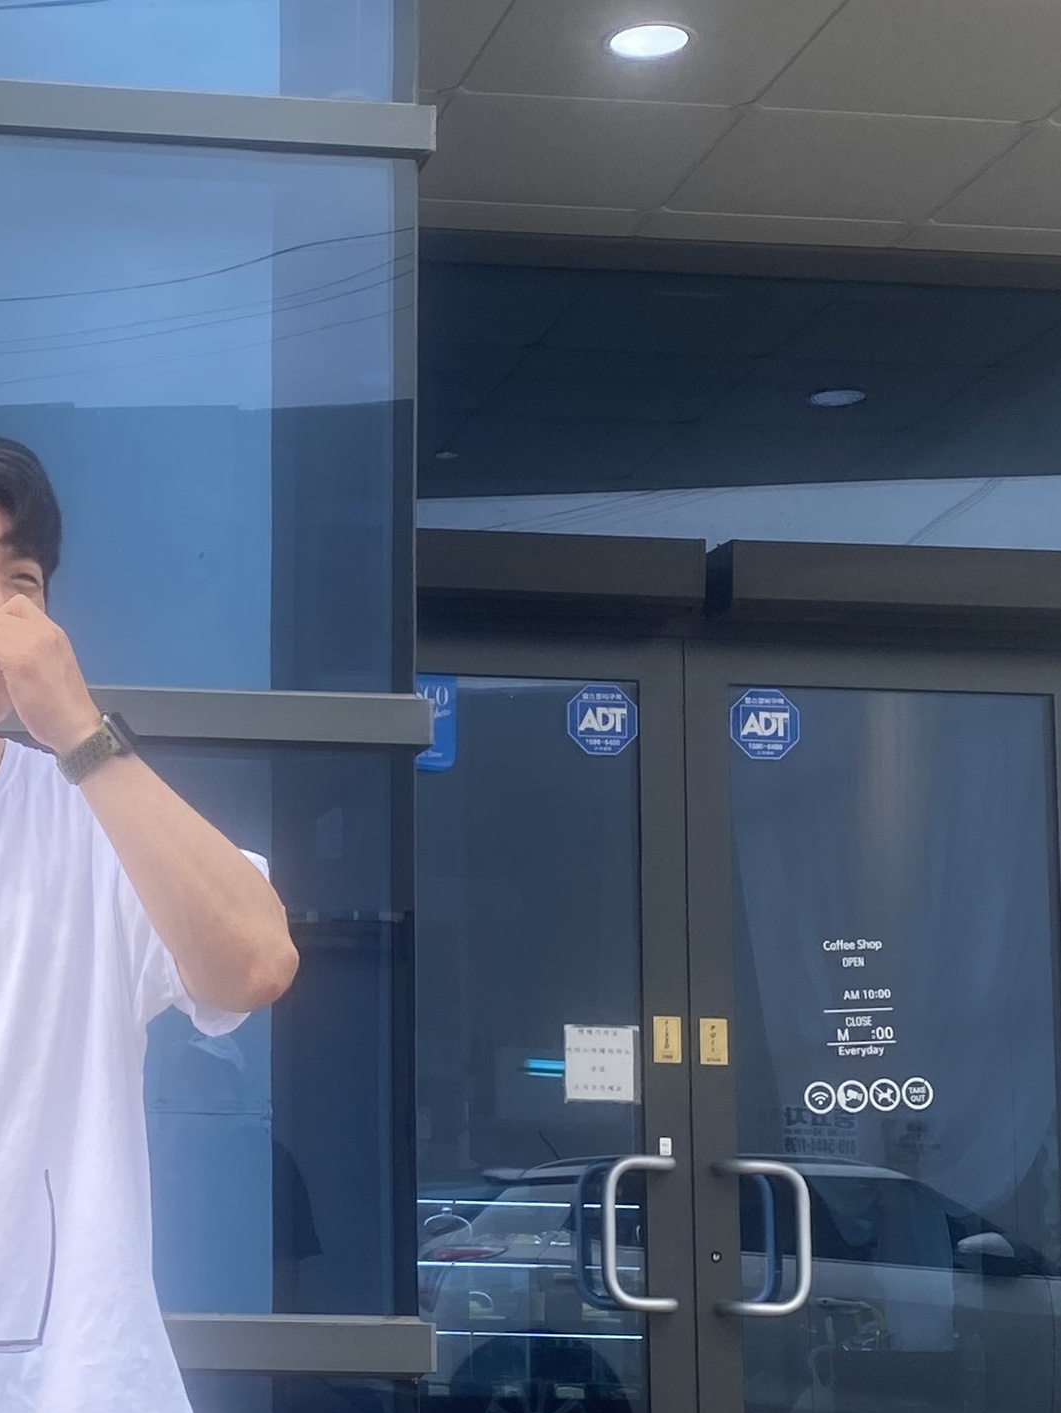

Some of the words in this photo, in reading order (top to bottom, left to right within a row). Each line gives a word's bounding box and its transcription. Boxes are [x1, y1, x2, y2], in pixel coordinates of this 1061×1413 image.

[578, 706, 627, 733] ADT
[740, 711, 789, 737] ADT
[823, 939, 856, 951] Coffee
[857, 939, 883, 951] Shop
[842, 957, 865, 967] OPEN
[843, 989, 860, 1000] AM
[862, 988, 892, 1000] 10:00
[845, 1016, 872, 1027] CLOSE
[838, 1045, 885, 1057] Everyday
[908, 1086, 926, 1094] TAKE
[910, 1095, 925, 1103] OUT
